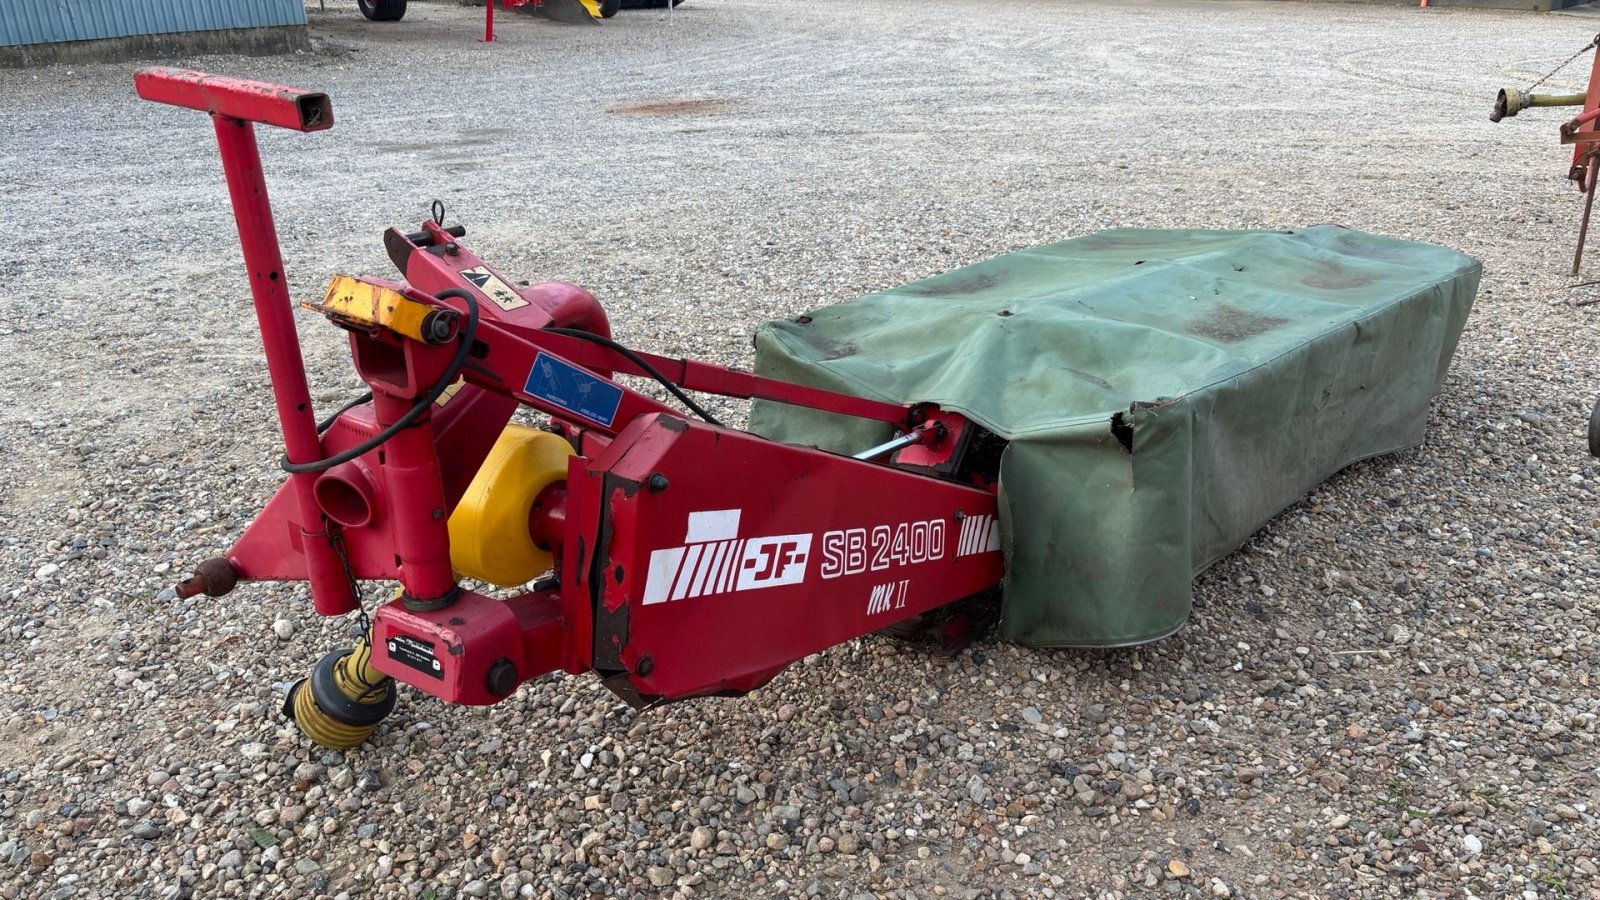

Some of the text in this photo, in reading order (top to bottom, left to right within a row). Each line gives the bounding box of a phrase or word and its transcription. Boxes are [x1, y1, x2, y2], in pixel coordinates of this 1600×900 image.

[821, 529, 867, 579] SB
[871, 519, 946, 571] 2400
[895, 580, 910, 609] II
